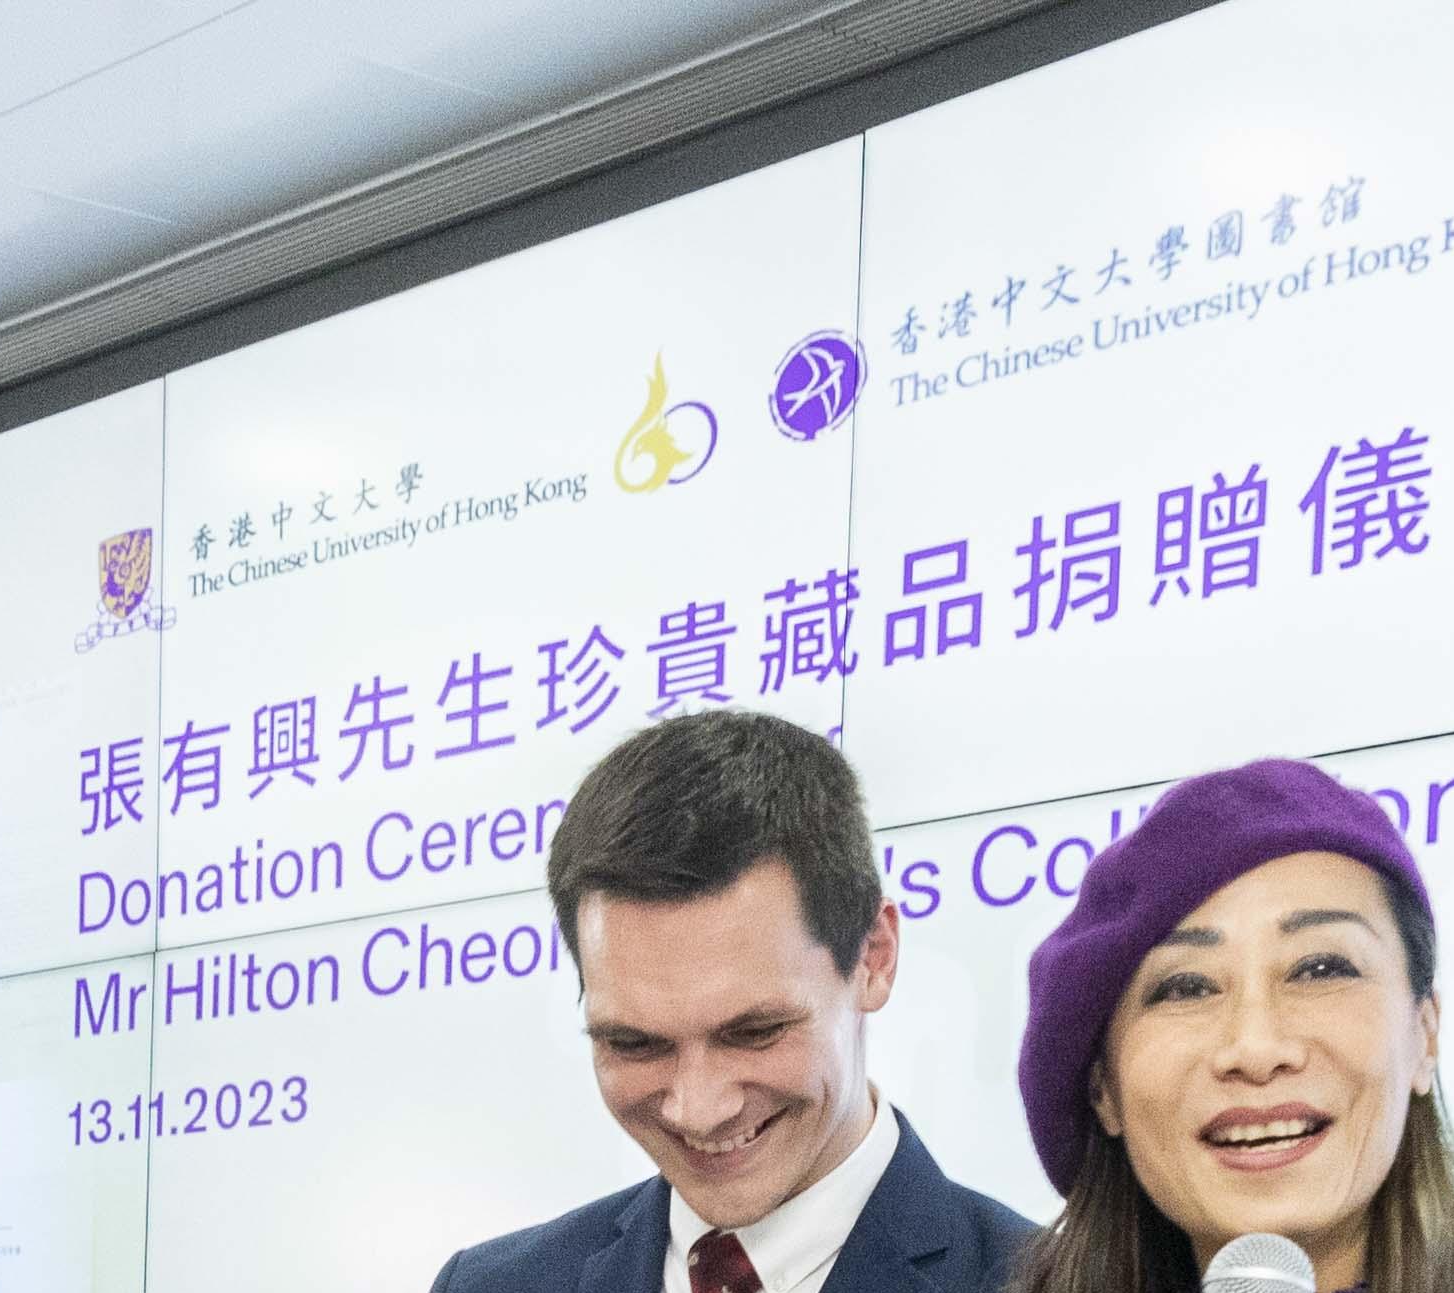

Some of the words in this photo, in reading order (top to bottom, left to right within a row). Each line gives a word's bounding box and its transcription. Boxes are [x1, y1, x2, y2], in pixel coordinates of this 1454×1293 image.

[889, 175, 1366, 356] 香港中文大學圖書館
[889, 372, 949, 407] The
[954, 333, 1084, 391] Chinese
[1092, 279, 1271, 352] University
[1277, 256, 1317, 299] of
[1324, 234, 1430, 287] Hong
[188, 569, 225, 599] The
[227, 547, 309, 587] Chinese
[312, 515, 422, 565] University
[424, 506, 450, 535] of
[452, 492, 518, 527] Hong
[522, 472, 589, 507] Kong
[189, 461, 424, 562] 香港中文大學
[77, 838, 344, 936] Donation
[72, 972, 147, 1040] Mr
[164, 950, 340, 1027] Hilton
[360, 920, 561, 998] Cheo
[67, 1074, 310, 1147] 13.11.2023
